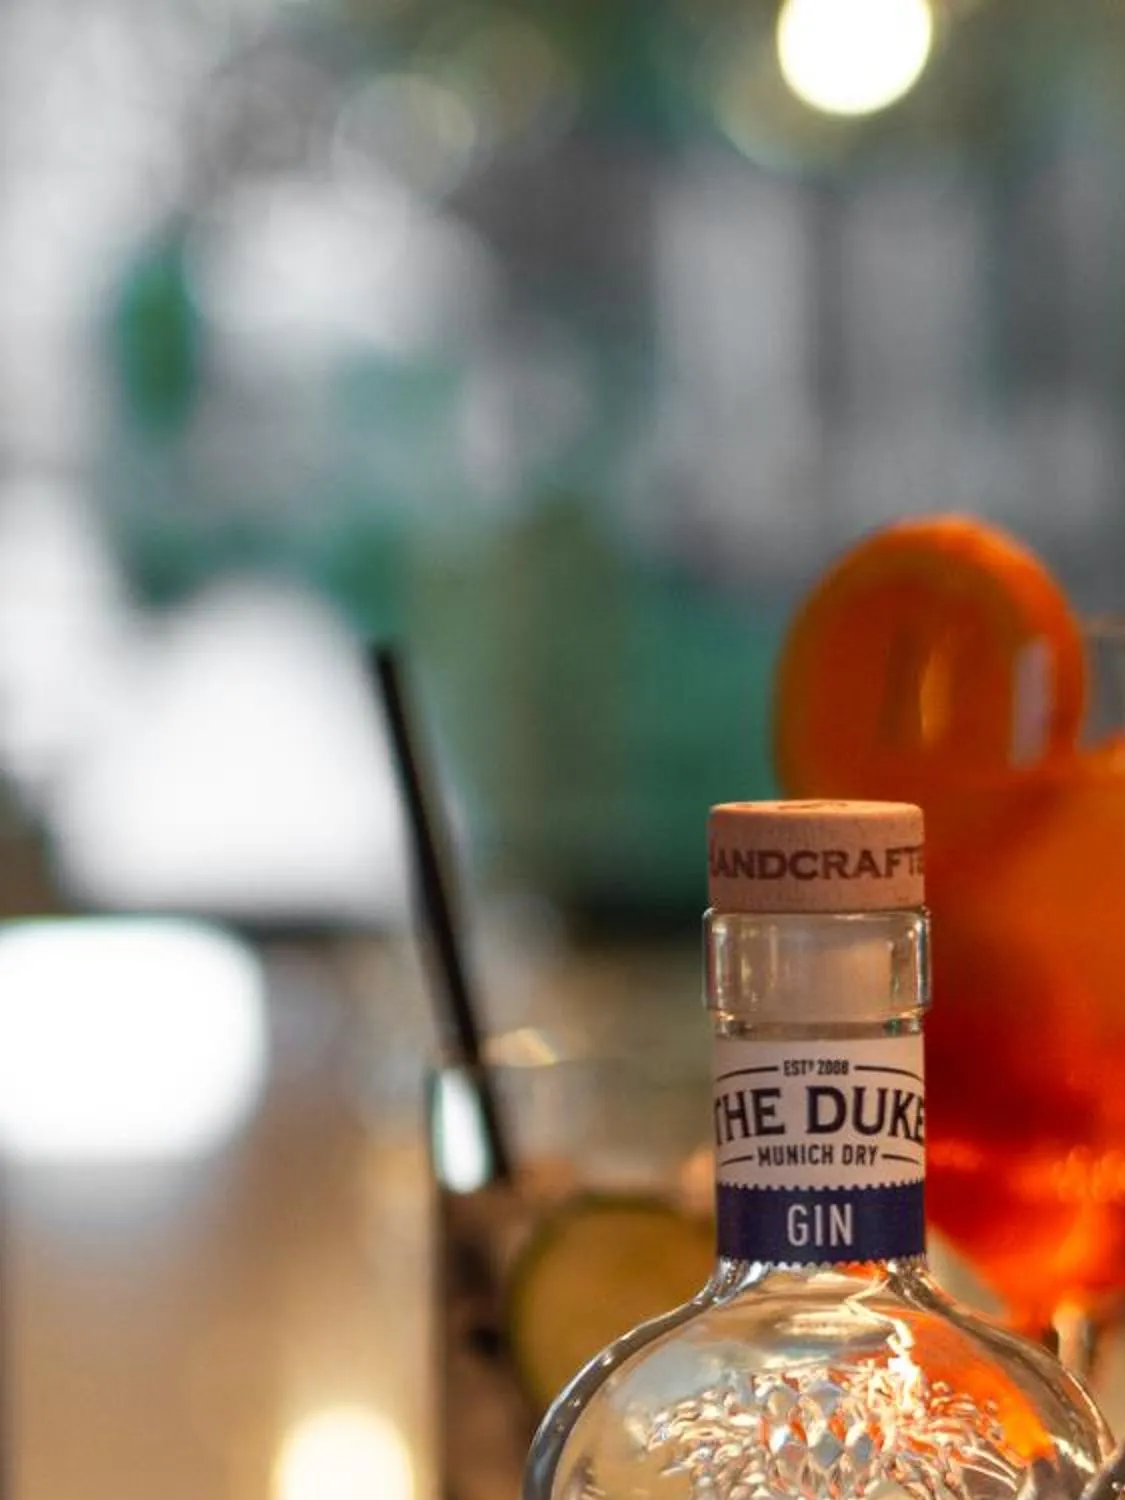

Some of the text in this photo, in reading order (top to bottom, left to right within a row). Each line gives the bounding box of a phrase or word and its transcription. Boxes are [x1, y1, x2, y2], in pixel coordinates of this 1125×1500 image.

[818, 1059, 849, 1075] 2008
[757, 1144, 878, 1166] MUNICH DRY
[787, 1203, 854, 1246] GIN
